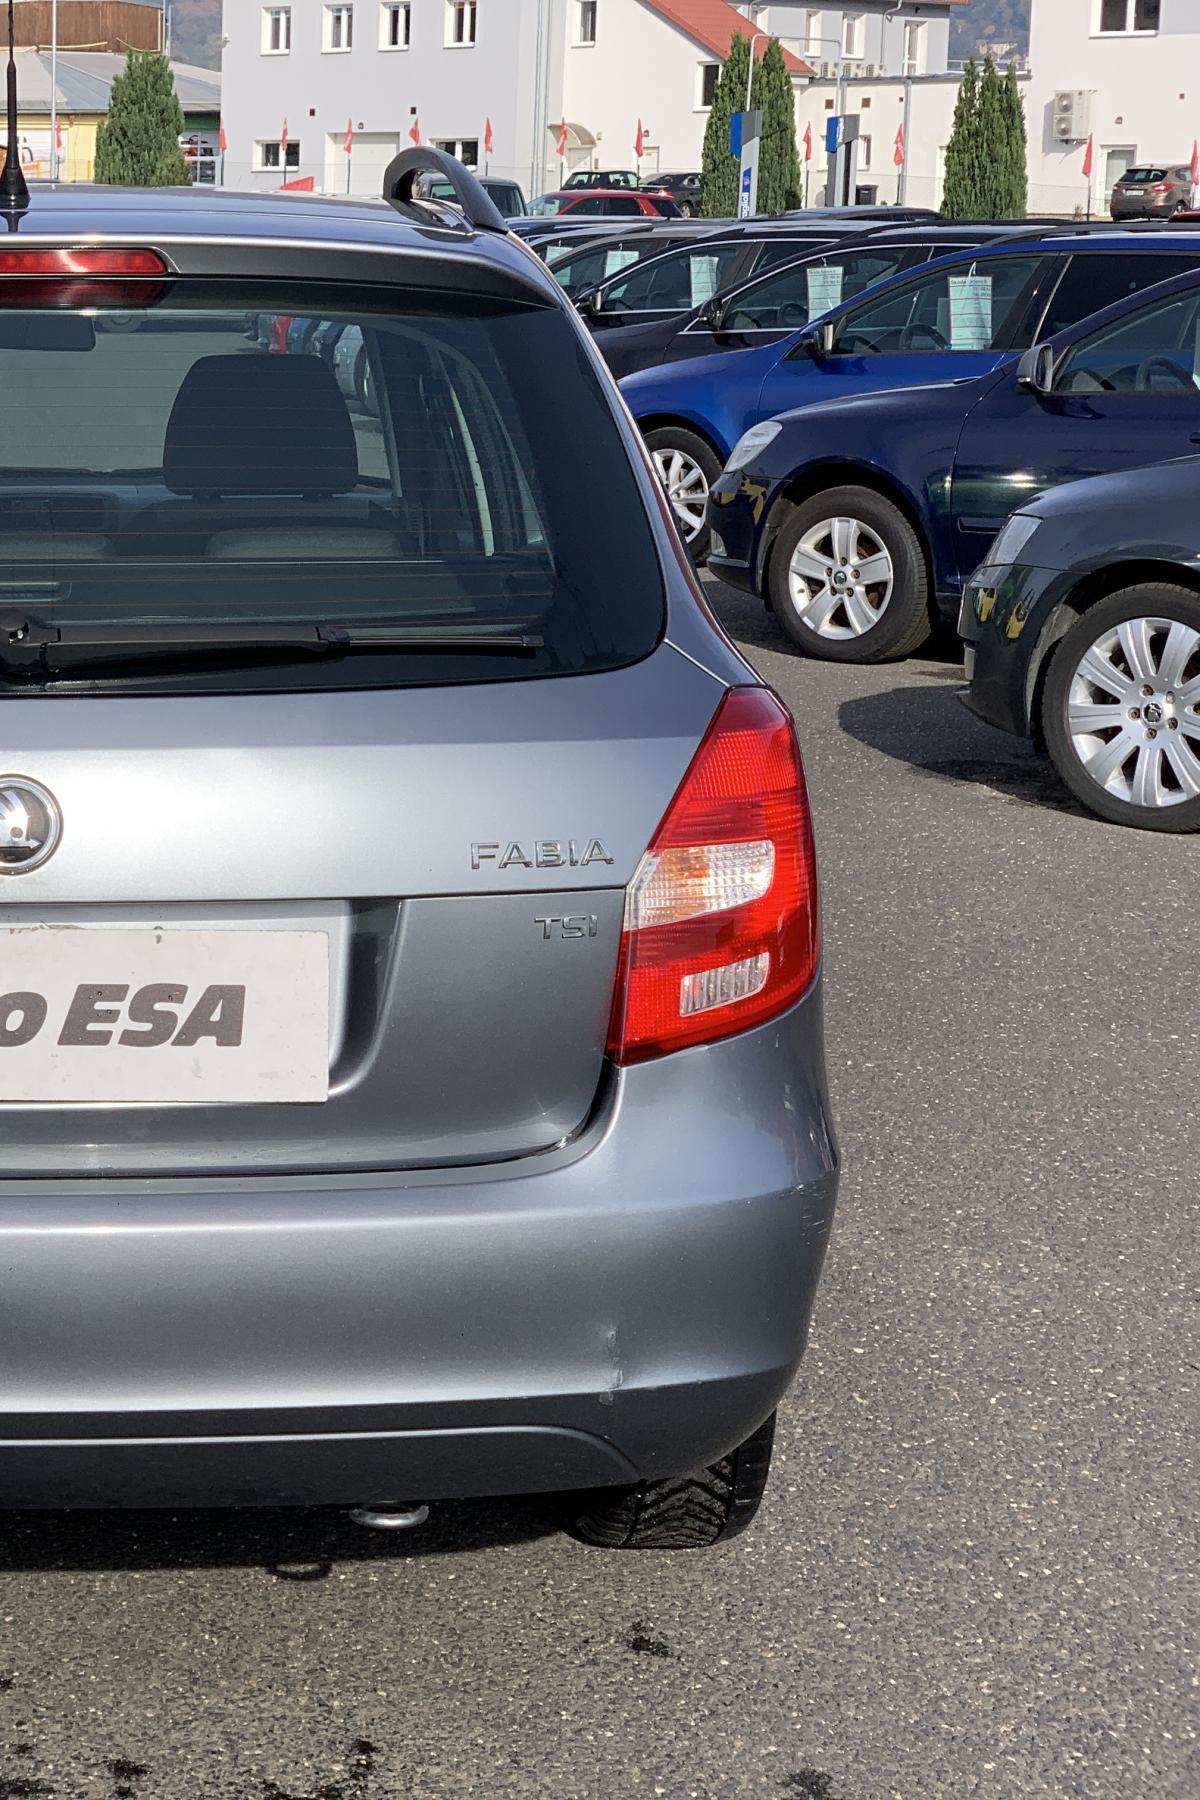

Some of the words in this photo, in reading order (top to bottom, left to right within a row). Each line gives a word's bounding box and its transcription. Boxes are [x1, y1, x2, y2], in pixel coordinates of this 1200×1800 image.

[470, 838, 614, 869] FABIA
[534, 914, 598, 939] TSI
[57, 983, 246, 1047] ESA
